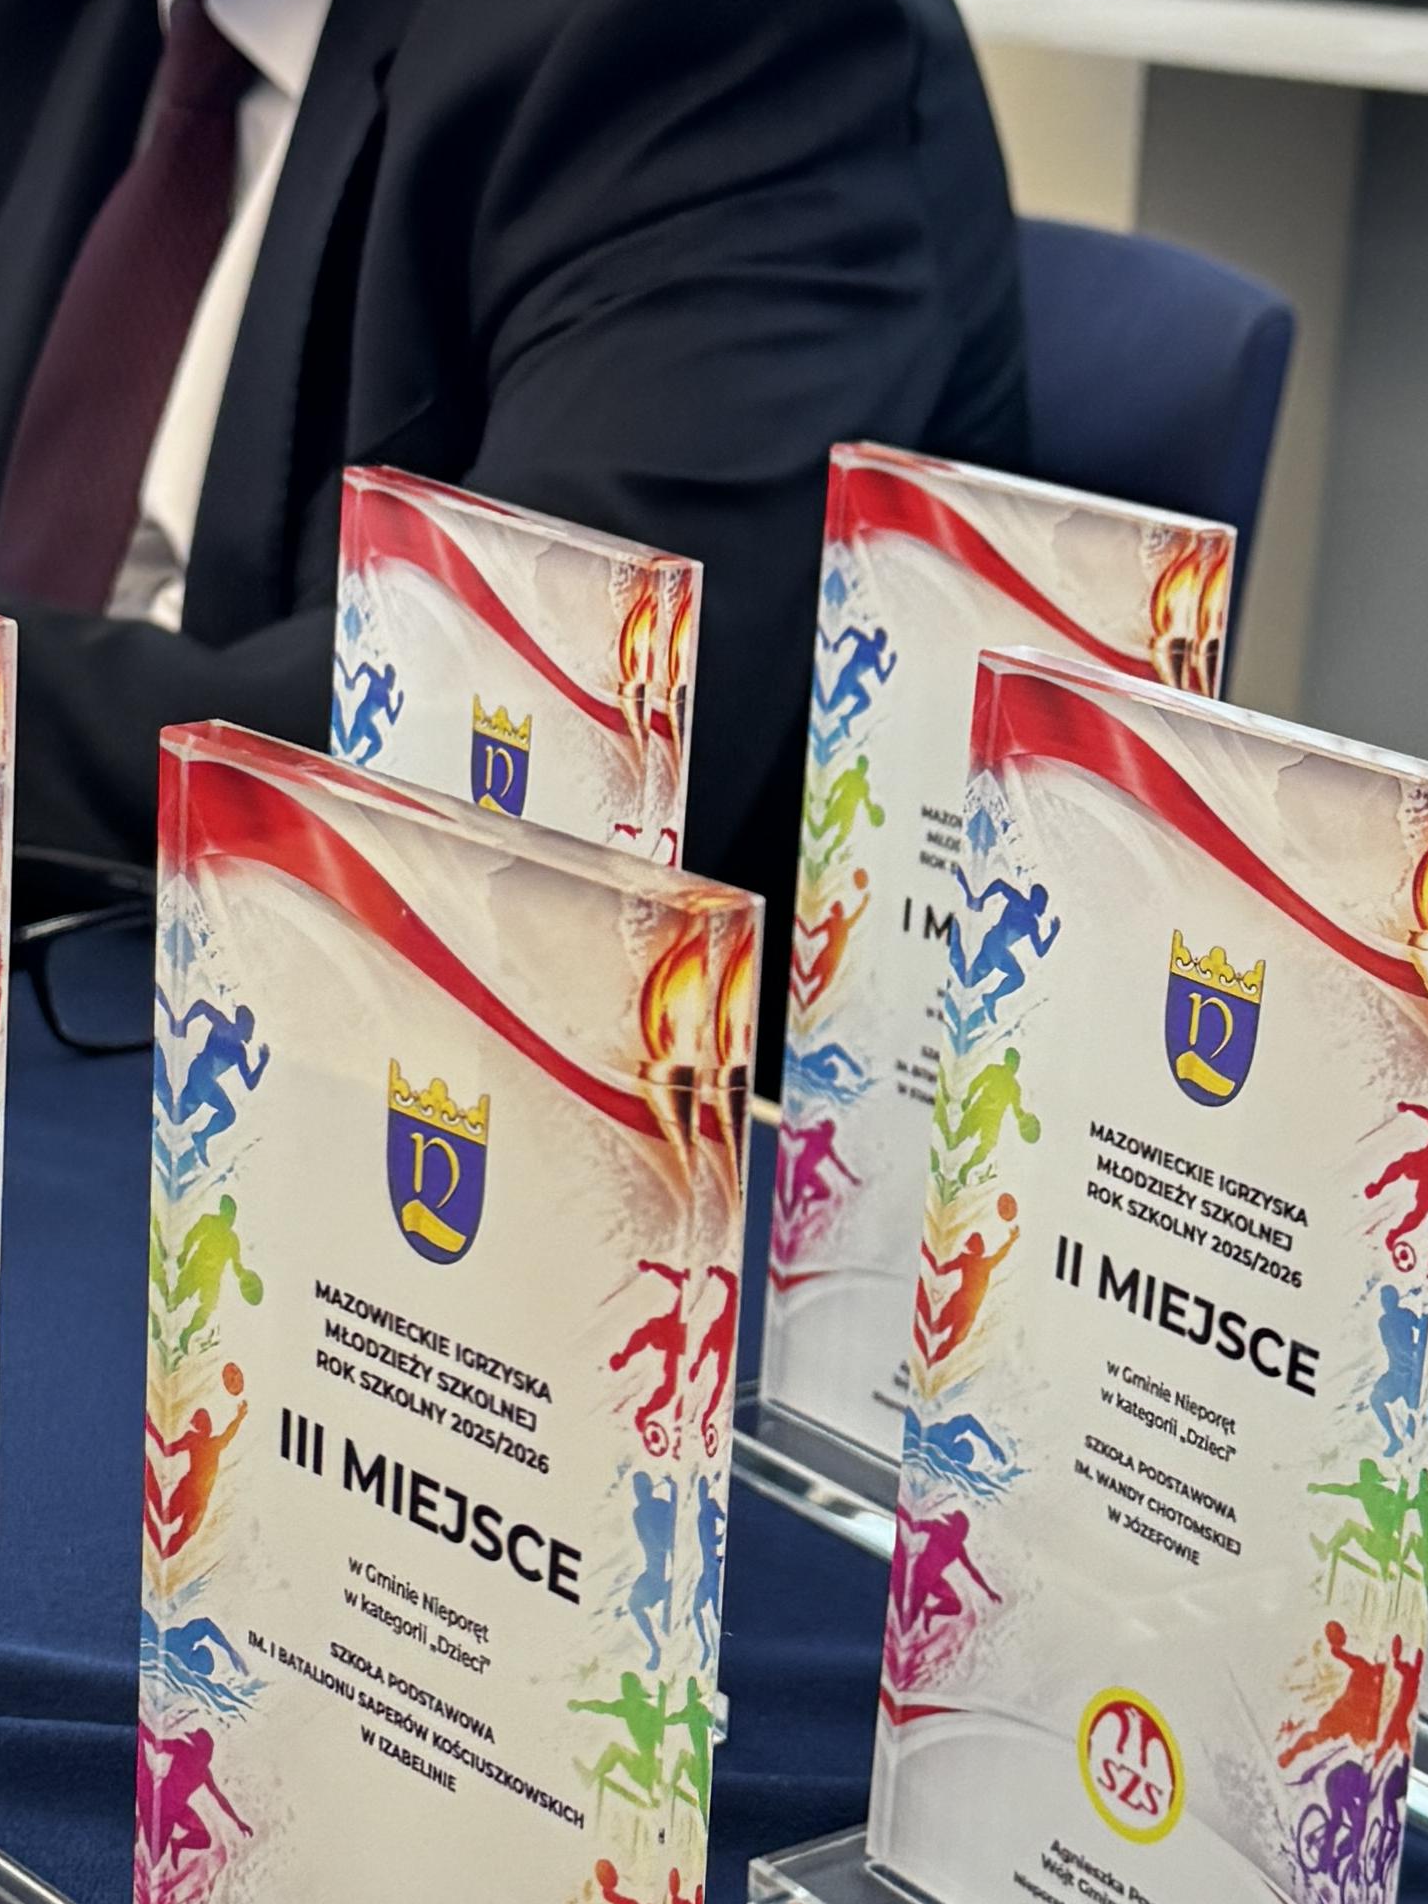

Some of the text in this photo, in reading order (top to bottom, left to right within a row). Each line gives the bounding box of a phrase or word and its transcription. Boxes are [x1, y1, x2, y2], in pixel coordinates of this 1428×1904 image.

[1089, 1121, 1309, 1227] MAZOWIECKIE IGRZYSKA
[1096, 1155, 1293, 1252] MŁODZIEŻY SZKOLNEJ
[1086, 1181, 1303, 1288] ROK SZKOLNY 2025/2026
[315, 1280, 553, 1403] MAZOWIECKIE IGRZYSKA
[1055, 1236, 1320, 1397] II MIEJSCE
[316, 1349, 550, 1474] ROK SZKOLNY 2025/2026
[325, 1319, 537, 1432] MŁODZIEŻY SZKOLNEJ
[1101, 1388, 1114, 1404] w
[1115, 1394, 1178, 1436] kategorii
[1106, 1361, 1236, 1435] w Gminie Nieporęt
[280, 1408, 582, 1604] III MIEJSCE
[1084, 1435, 1237, 1522] SZKOŁA PODSTAWOWA
[1096, 1470, 1146, 1505] WANDY
[1146, 1498, 1242, 1556] CHOTOMSKIEJ
[1107, 1505, 1200, 1565] W JÓZEFOWIE
[343, 1589, 492, 1673] w kategorii „Dzieci”
[348, 1557, 489, 1643] w Gminie Nieporęt
[248, 1631, 268, 1653] IM.
[278, 1647, 355, 1700] BATALIONU
[357, 1692, 429, 1741] SAPERÓW
[432, 1732, 585, 1829] KOŚCIUSZKOWSKICH
[330, 1642, 496, 1744] SZKOŁA PODSTAWOWA
[360, 1725, 457, 1792] W IZABELINIE
[1096, 1758, 1164, 1815] SZS
